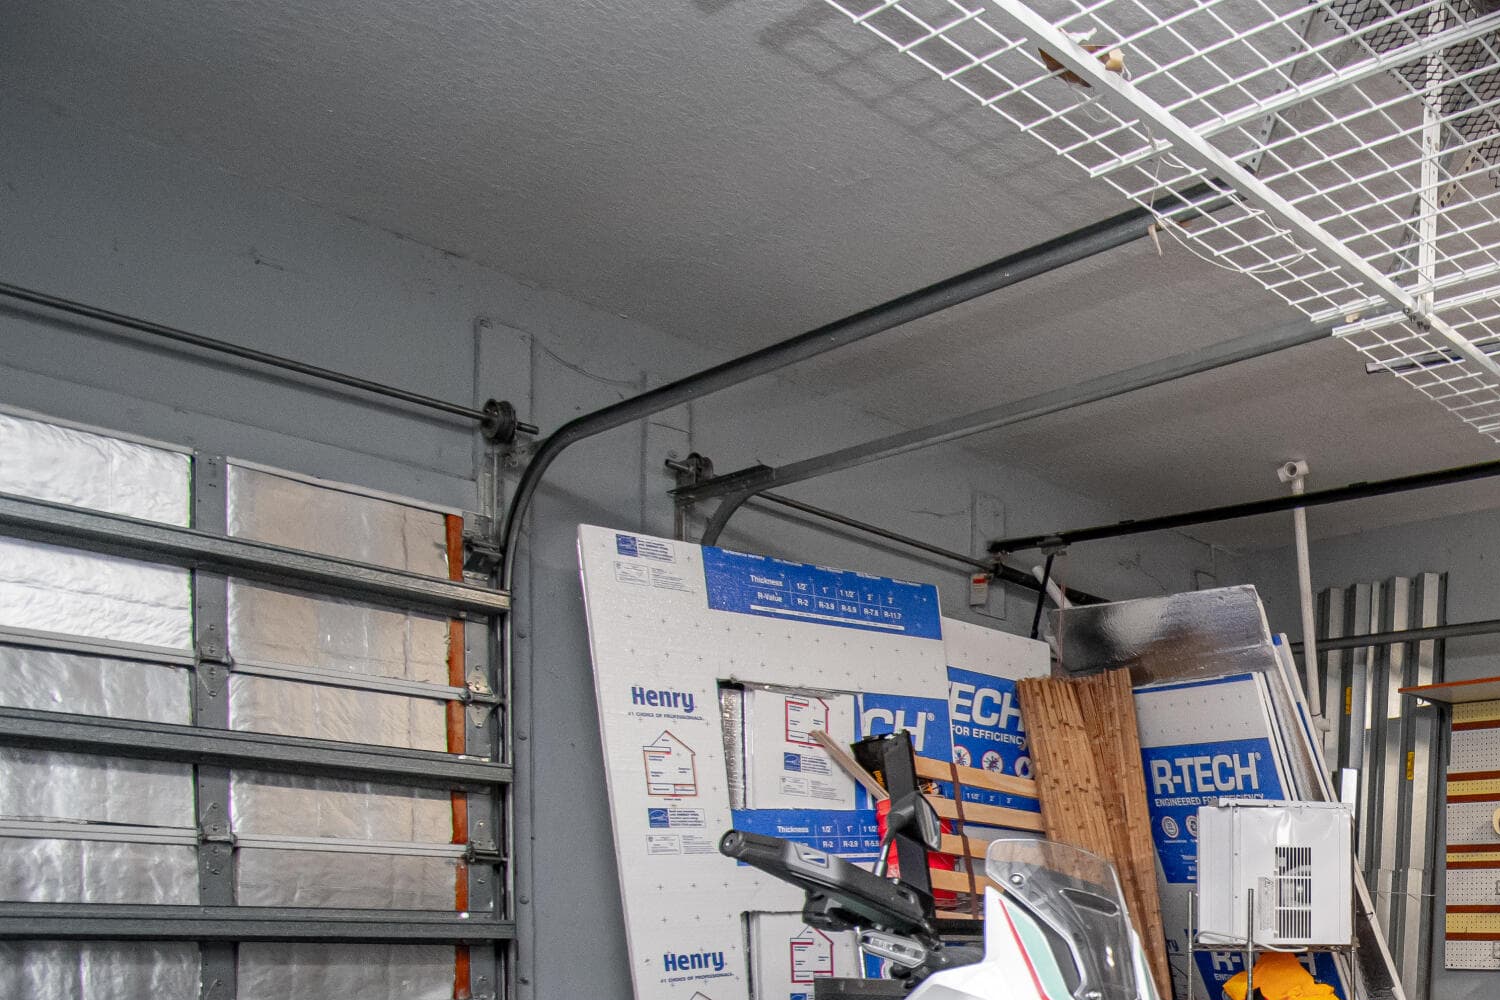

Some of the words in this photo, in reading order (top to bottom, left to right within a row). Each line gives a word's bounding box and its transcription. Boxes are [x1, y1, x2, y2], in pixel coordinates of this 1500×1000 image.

[631, 686, 696, 713] Henry
[949, 681, 1025, 732] ECH
[1150, 752, 1260, 794] R-TECH
[1155, 796, 1201, 807] ENGINEERED
[663, 952, 725, 972] Henry
